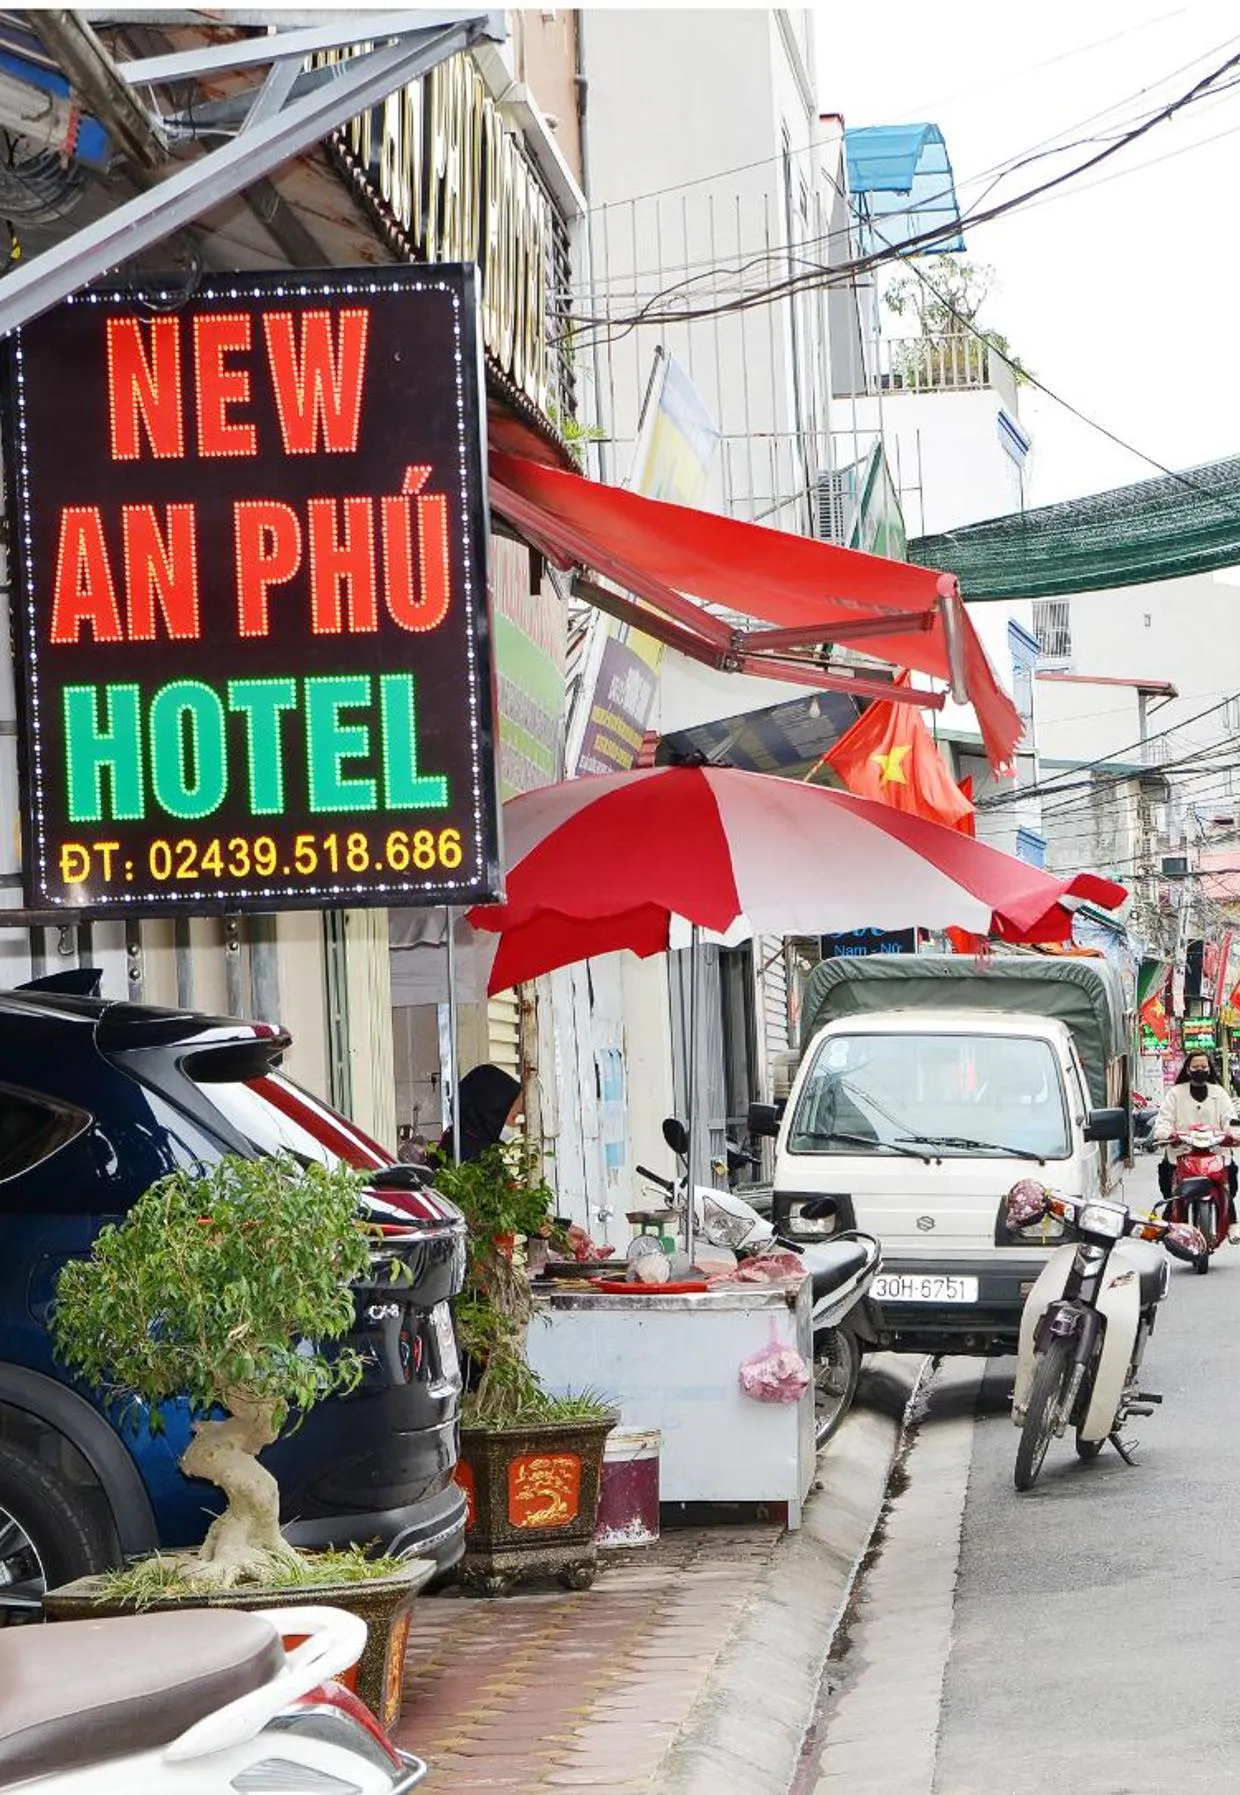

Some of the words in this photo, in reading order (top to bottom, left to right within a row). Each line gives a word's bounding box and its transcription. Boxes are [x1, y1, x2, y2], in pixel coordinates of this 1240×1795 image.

[106, 309, 369, 460] NEW
[50, 503, 200, 644] AN
[234, 465, 451, 638] PHÚ
[61, 673, 449, 823] HOTEL
[58, 841, 136, 884] ĐT:
[149, 828, 463, 882] 02439.518.686
[368, 1303, 400, 1320] CX-8
[876, 1278, 966, 1300] 30H-6751
